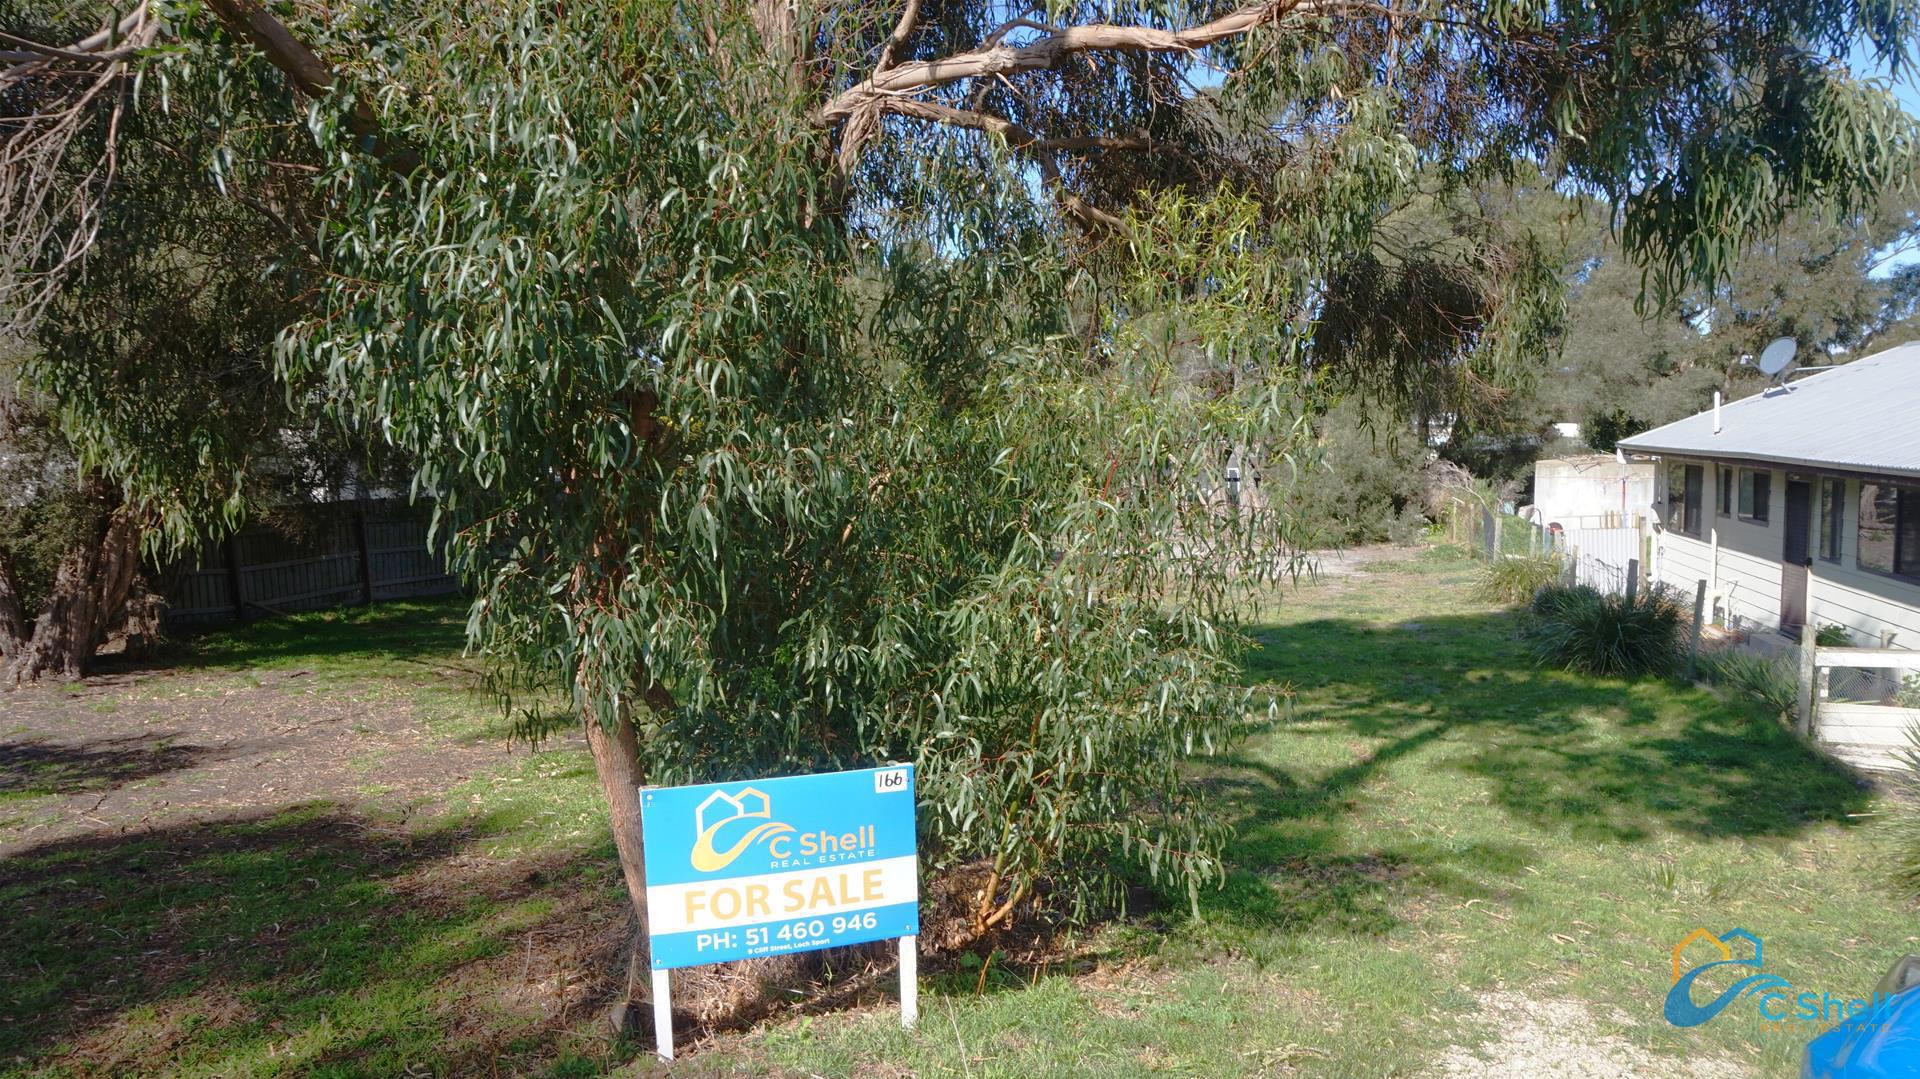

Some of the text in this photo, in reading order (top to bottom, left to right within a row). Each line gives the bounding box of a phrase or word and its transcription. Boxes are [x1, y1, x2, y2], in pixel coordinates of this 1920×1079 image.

[880, 771, 903, 788] 166
[769, 825, 875, 859] C Shell
[770, 849, 875, 869] REAL ESTATE
[684, 869, 884, 924] FOR SALE
[697, 911, 878, 952] PH: 51 460 946
[770, 943, 793, 953] Street,
[793, 940, 810, 948] Loch
[811, 938, 830, 947] Sport
